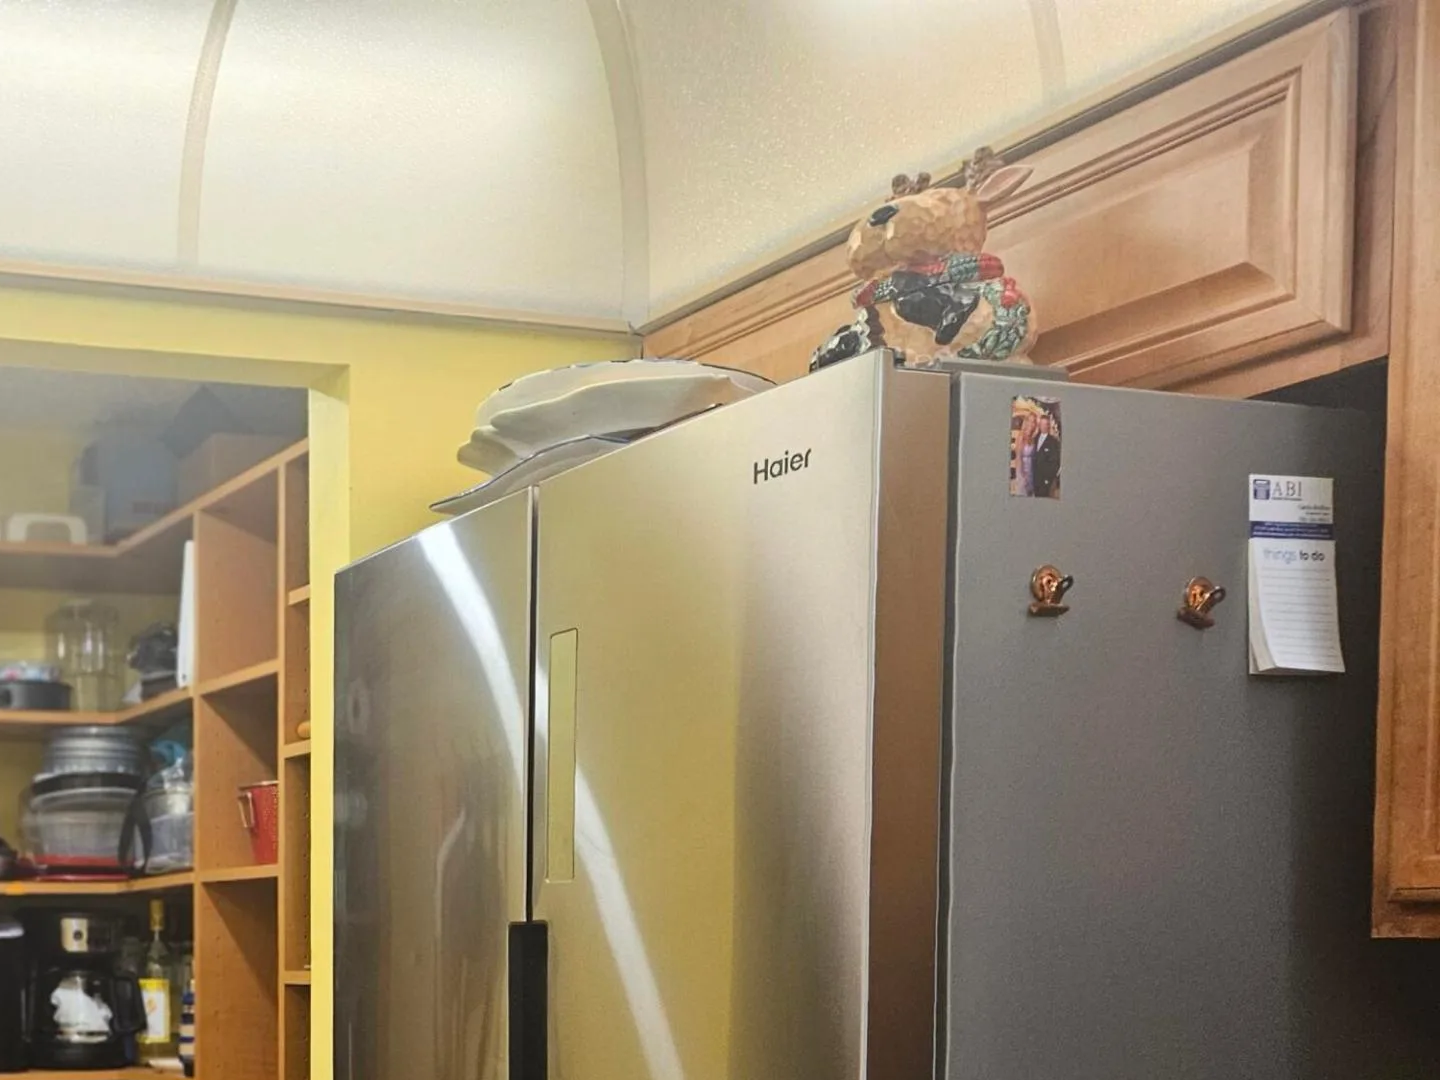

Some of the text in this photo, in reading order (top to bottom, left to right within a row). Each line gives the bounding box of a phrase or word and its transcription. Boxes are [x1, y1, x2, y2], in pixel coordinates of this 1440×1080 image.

[753, 448, 812, 485] Haier
[1273, 481, 1303, 498] ABI
[1299, 550, 1310, 561] to
[1311, 550, 1326, 562] do
